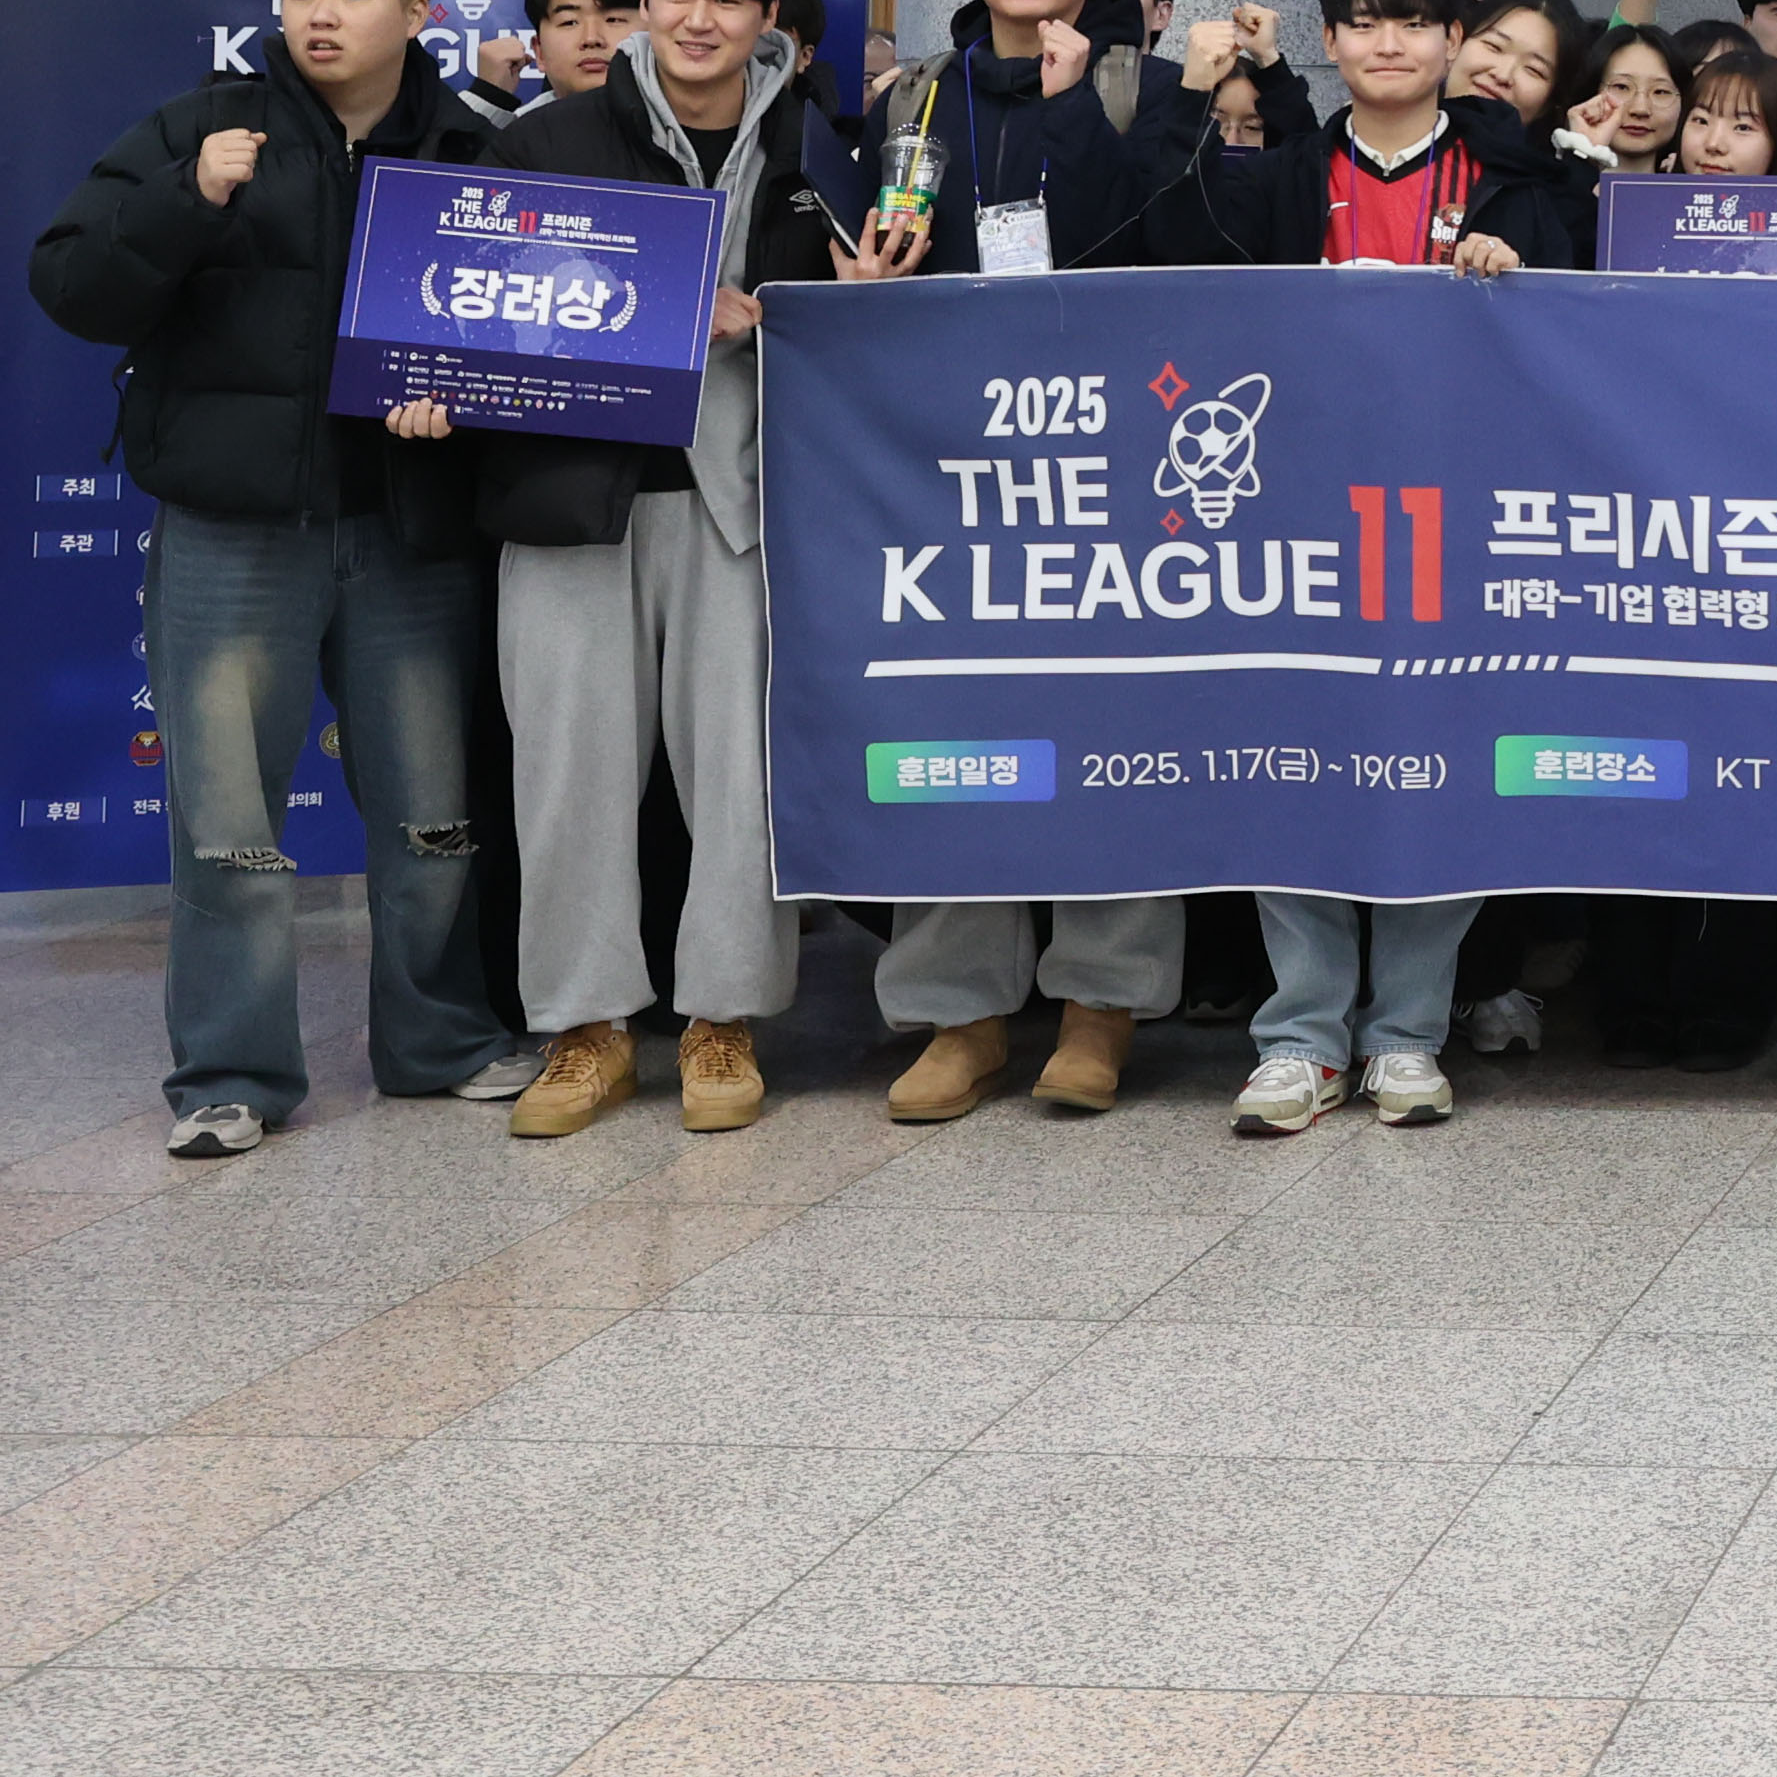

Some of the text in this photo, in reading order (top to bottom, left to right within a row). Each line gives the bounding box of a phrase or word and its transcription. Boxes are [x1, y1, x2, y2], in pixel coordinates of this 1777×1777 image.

[462, 187, 483, 199] 2025
[452, 198, 481, 214] THE
[1685, 206, 1713, 218] THE
[439, 210, 537, 234] K LEAGUE 11
[541, 213, 592, 231] 프리시즌
[1689, 219, 1748, 232] LEAGUE
[449, 267, 610, 330] 장려상
[983, 375, 1105, 436] 2025
[62, 478, 96, 497] 주최
[938, 456, 1108, 526] THE
[60, 534, 94, 553] 주관
[881, 486, 1443, 622] K LEAGUE 11
[1484, 579, 1653, 623] 대학-기업
[1663, 584, 1769, 629] 협력형
[896, 755, 1018, 787] 훈련일정
[1082, 752, 1189, 787] 2025.
[1533, 749, 1656, 783] 훈련장소
[1716, 758, 1769, 791] KT
[47, 802, 81, 822] 후원
[133, 800, 162, 815] 전국
